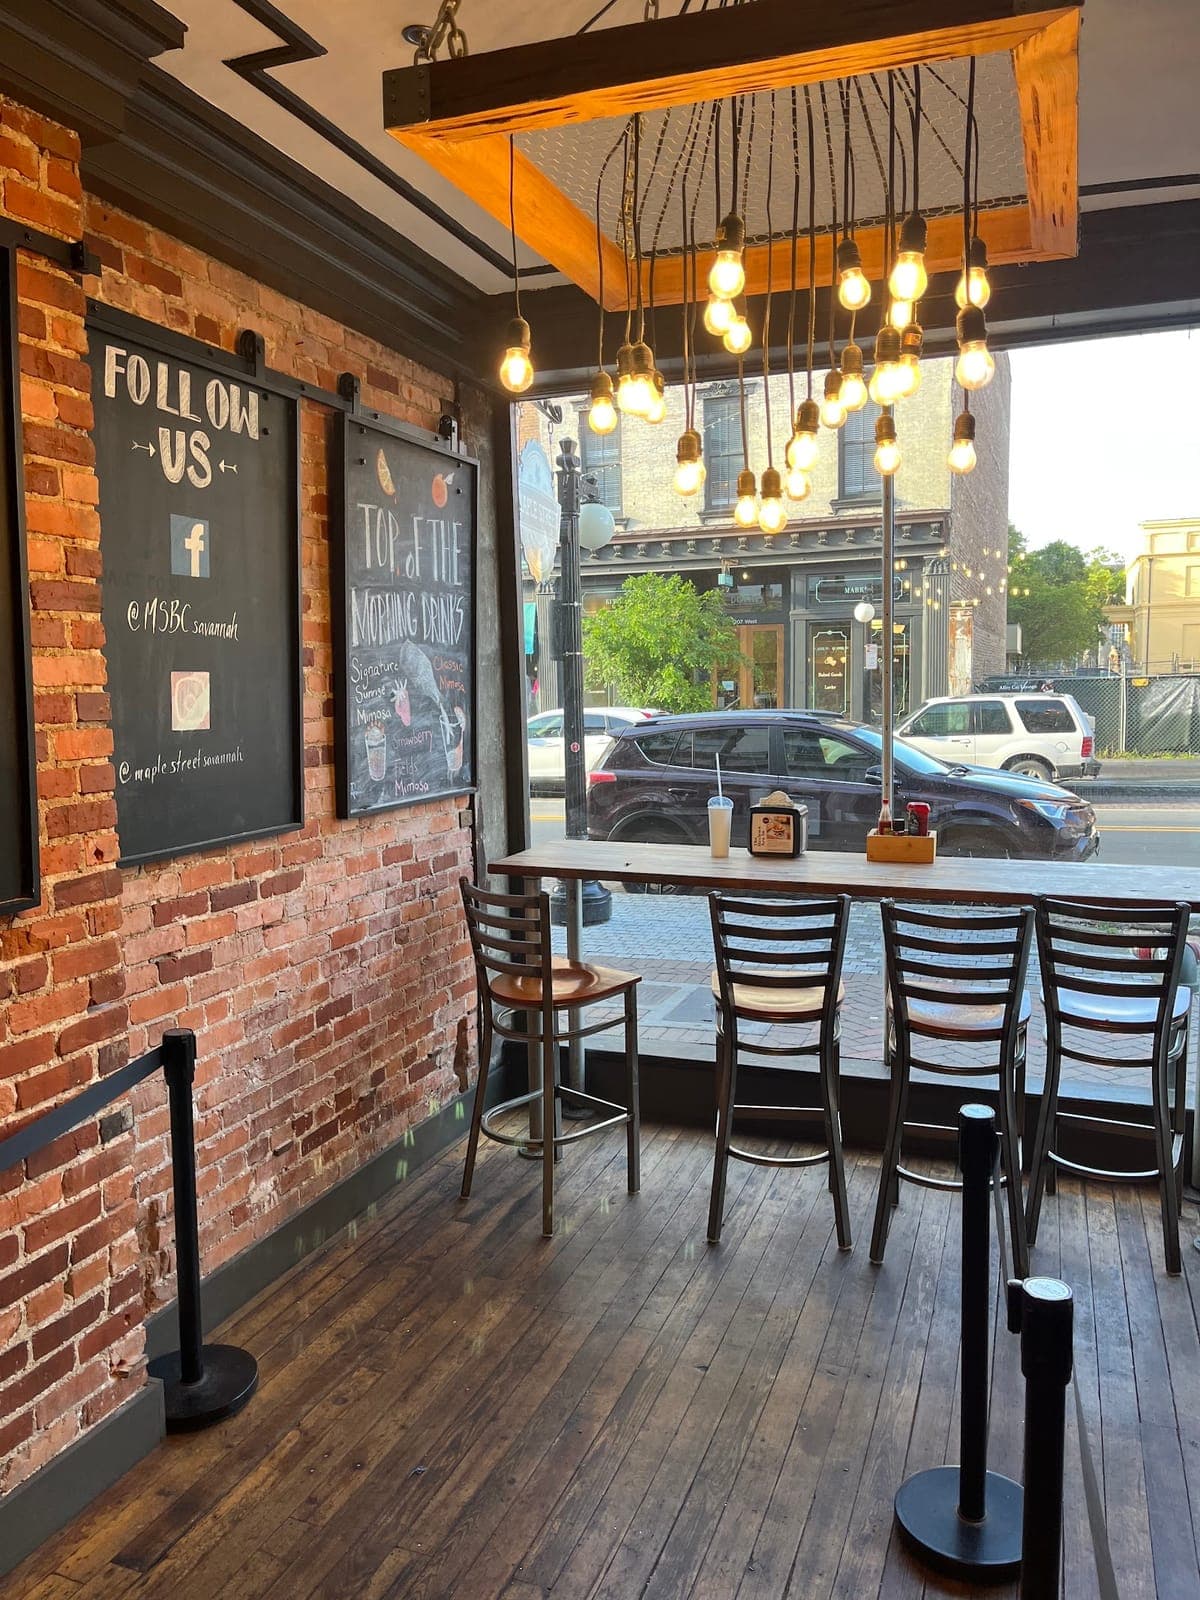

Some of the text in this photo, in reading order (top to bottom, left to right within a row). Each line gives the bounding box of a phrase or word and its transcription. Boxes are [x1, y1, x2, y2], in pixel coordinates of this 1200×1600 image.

[105, 345, 259, 440] FOLLOW
[158, 427, 212, 488] US
[357, 503, 399, 573] TOP
[426, 518, 462, 585] THE
[351, 586, 464, 647] MORNING DRINKS
[351, 657, 399, 690] Signature
[355, 685, 386, 704] Sunrise
[357, 708, 392, 725] Mimosa
[394, 779, 429, 797] Mimosa
